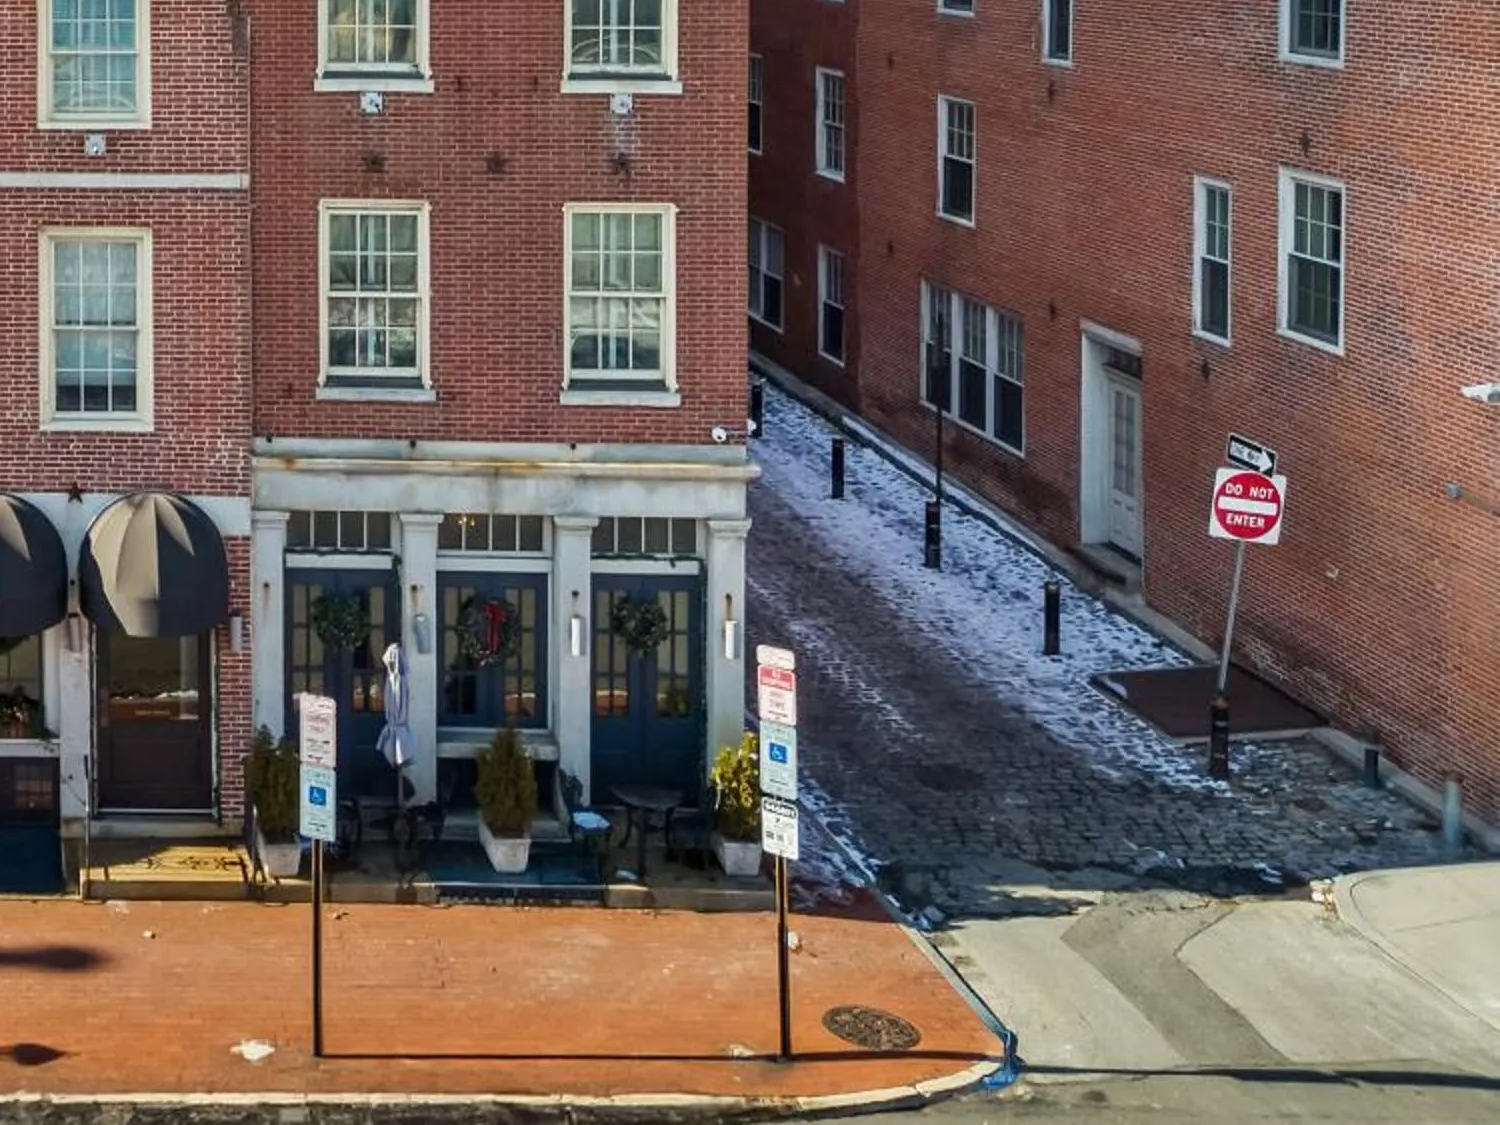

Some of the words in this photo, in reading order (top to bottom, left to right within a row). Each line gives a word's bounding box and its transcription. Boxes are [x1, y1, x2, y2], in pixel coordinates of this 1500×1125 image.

[1225, 482, 1243, 495] DO
[1250, 486, 1274, 499] NOT
[1226, 513, 1265, 528] ENTER
